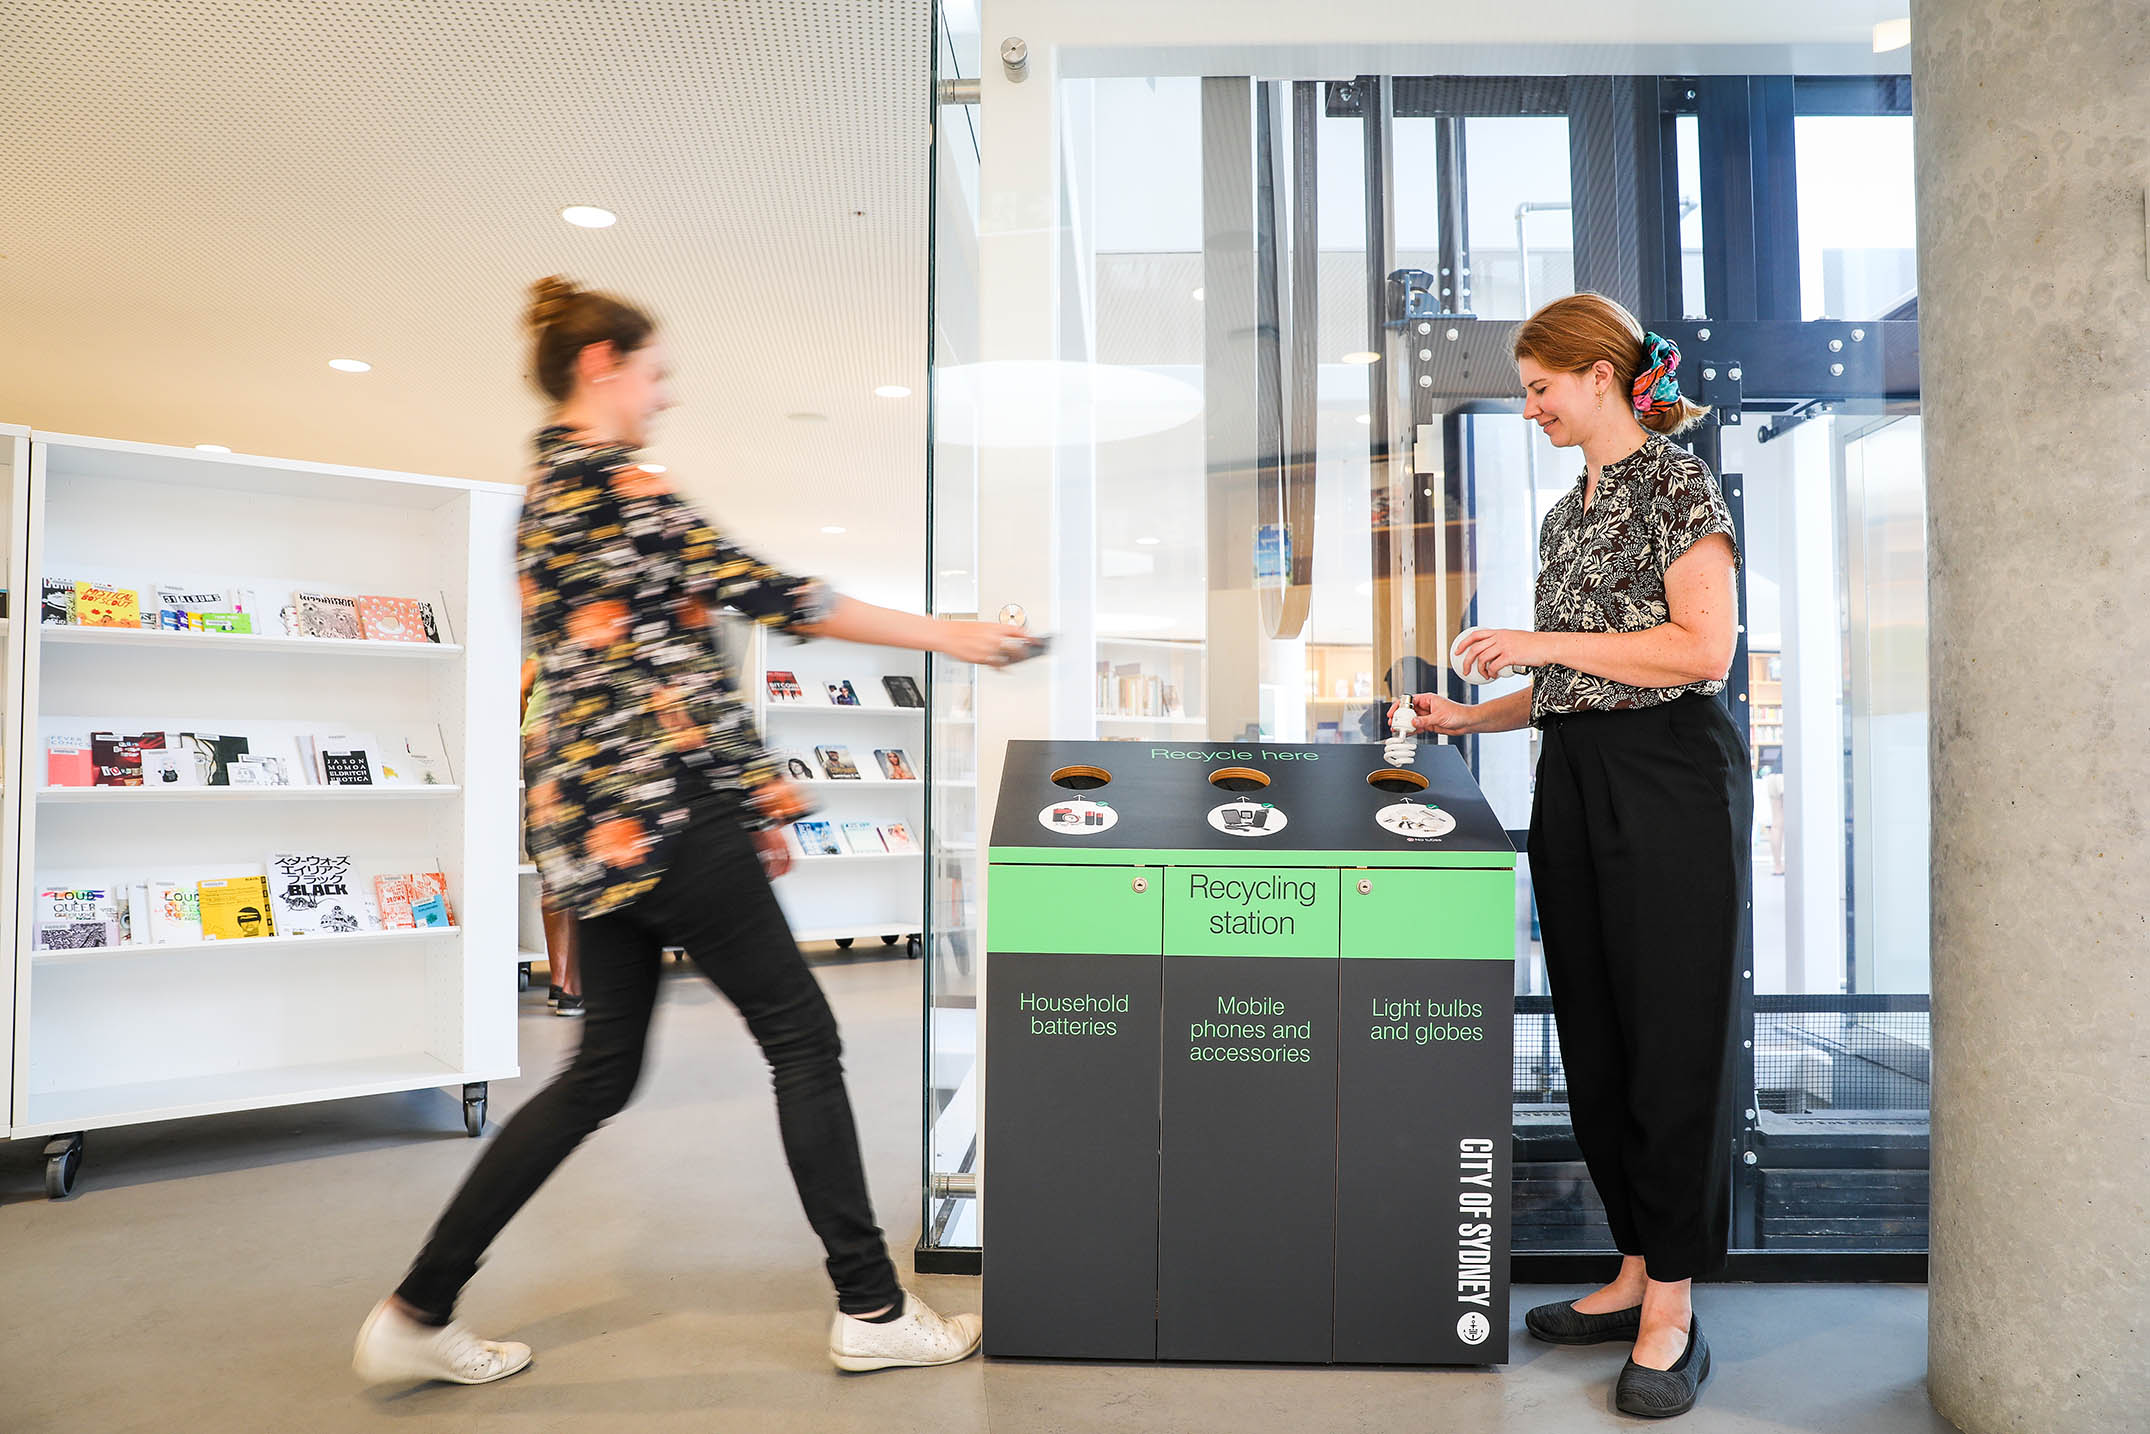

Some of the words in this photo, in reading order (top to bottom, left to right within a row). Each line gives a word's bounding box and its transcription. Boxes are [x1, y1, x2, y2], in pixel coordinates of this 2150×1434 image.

[85, 588, 133, 601] MYSTICAL
[178, 594, 221, 603] ALBUMS
[1151, 748, 1253, 762] Recycle
[1261, 749, 1319, 761] here
[54, 892, 95, 901] LOUD
[288, 884, 348, 896] BLACK
[1190, 873, 1316, 907] Recycling
[53, 903, 96, 913] QUEER
[1209, 910, 1295, 935] station
[1020, 992, 1129, 1013] Household
[1218, 996, 1285, 1016] Mobile
[1372, 998, 1421, 1021] Light
[1428, 998, 1483, 1018] bulbs
[1031, 1016, 1118, 1036] batteries
[1190, 1019, 1266, 1042] phones
[1272, 1020, 1312, 1039] and
[1370, 1022, 1409, 1040] and
[1415, 1022, 1483, 1045] globes
[1190, 1043, 1311, 1063] accessories
[1459, 1138, 1494, 1188] CITY
[1458, 1192, 1493, 1219] OF
[1457, 1223, 1492, 1307] SYDNEY
